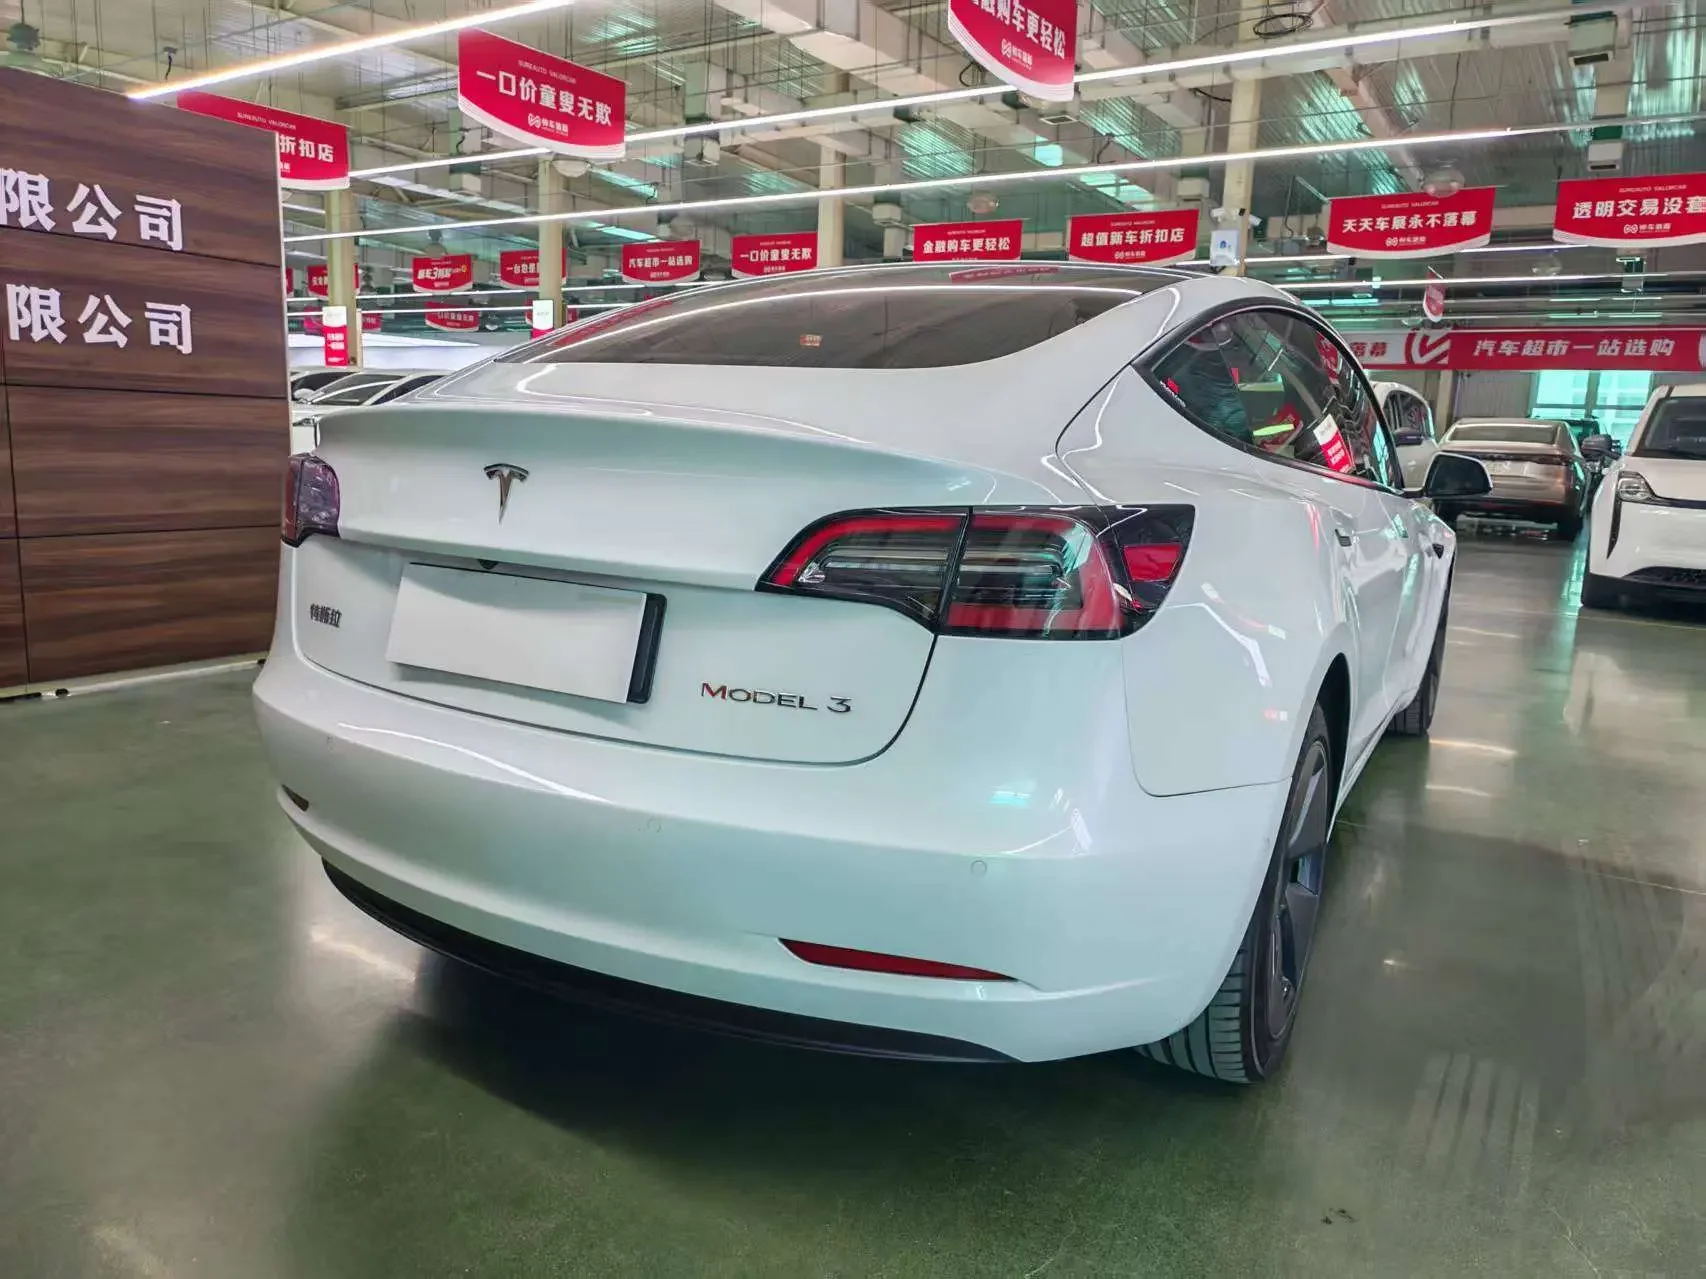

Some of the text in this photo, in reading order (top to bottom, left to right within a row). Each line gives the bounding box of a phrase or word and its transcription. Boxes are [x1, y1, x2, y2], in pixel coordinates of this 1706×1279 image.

[972, 0, 1066, 59] 购车更轻松
[476, 70, 612, 126] 一口价童叟无欺
[279, 134, 334, 163] 折扣店
[0, 168, 183, 251] 限公司
[1342, 210, 1478, 234] 天天车展永不落幕
[923, 237, 1010, 254] 金融购车更轻松
[1081, 227, 1185, 247] 超值新车折扣店
[628, 255, 693, 268] 汽车超市一站选购
[740, 247, 812, 262] 一口价童叟无欺
[6, 284, 192, 355] 限公司
[1473, 338, 1676, 357] 汽车超市一站选购
[701, 682, 852, 713] MODEL 3
